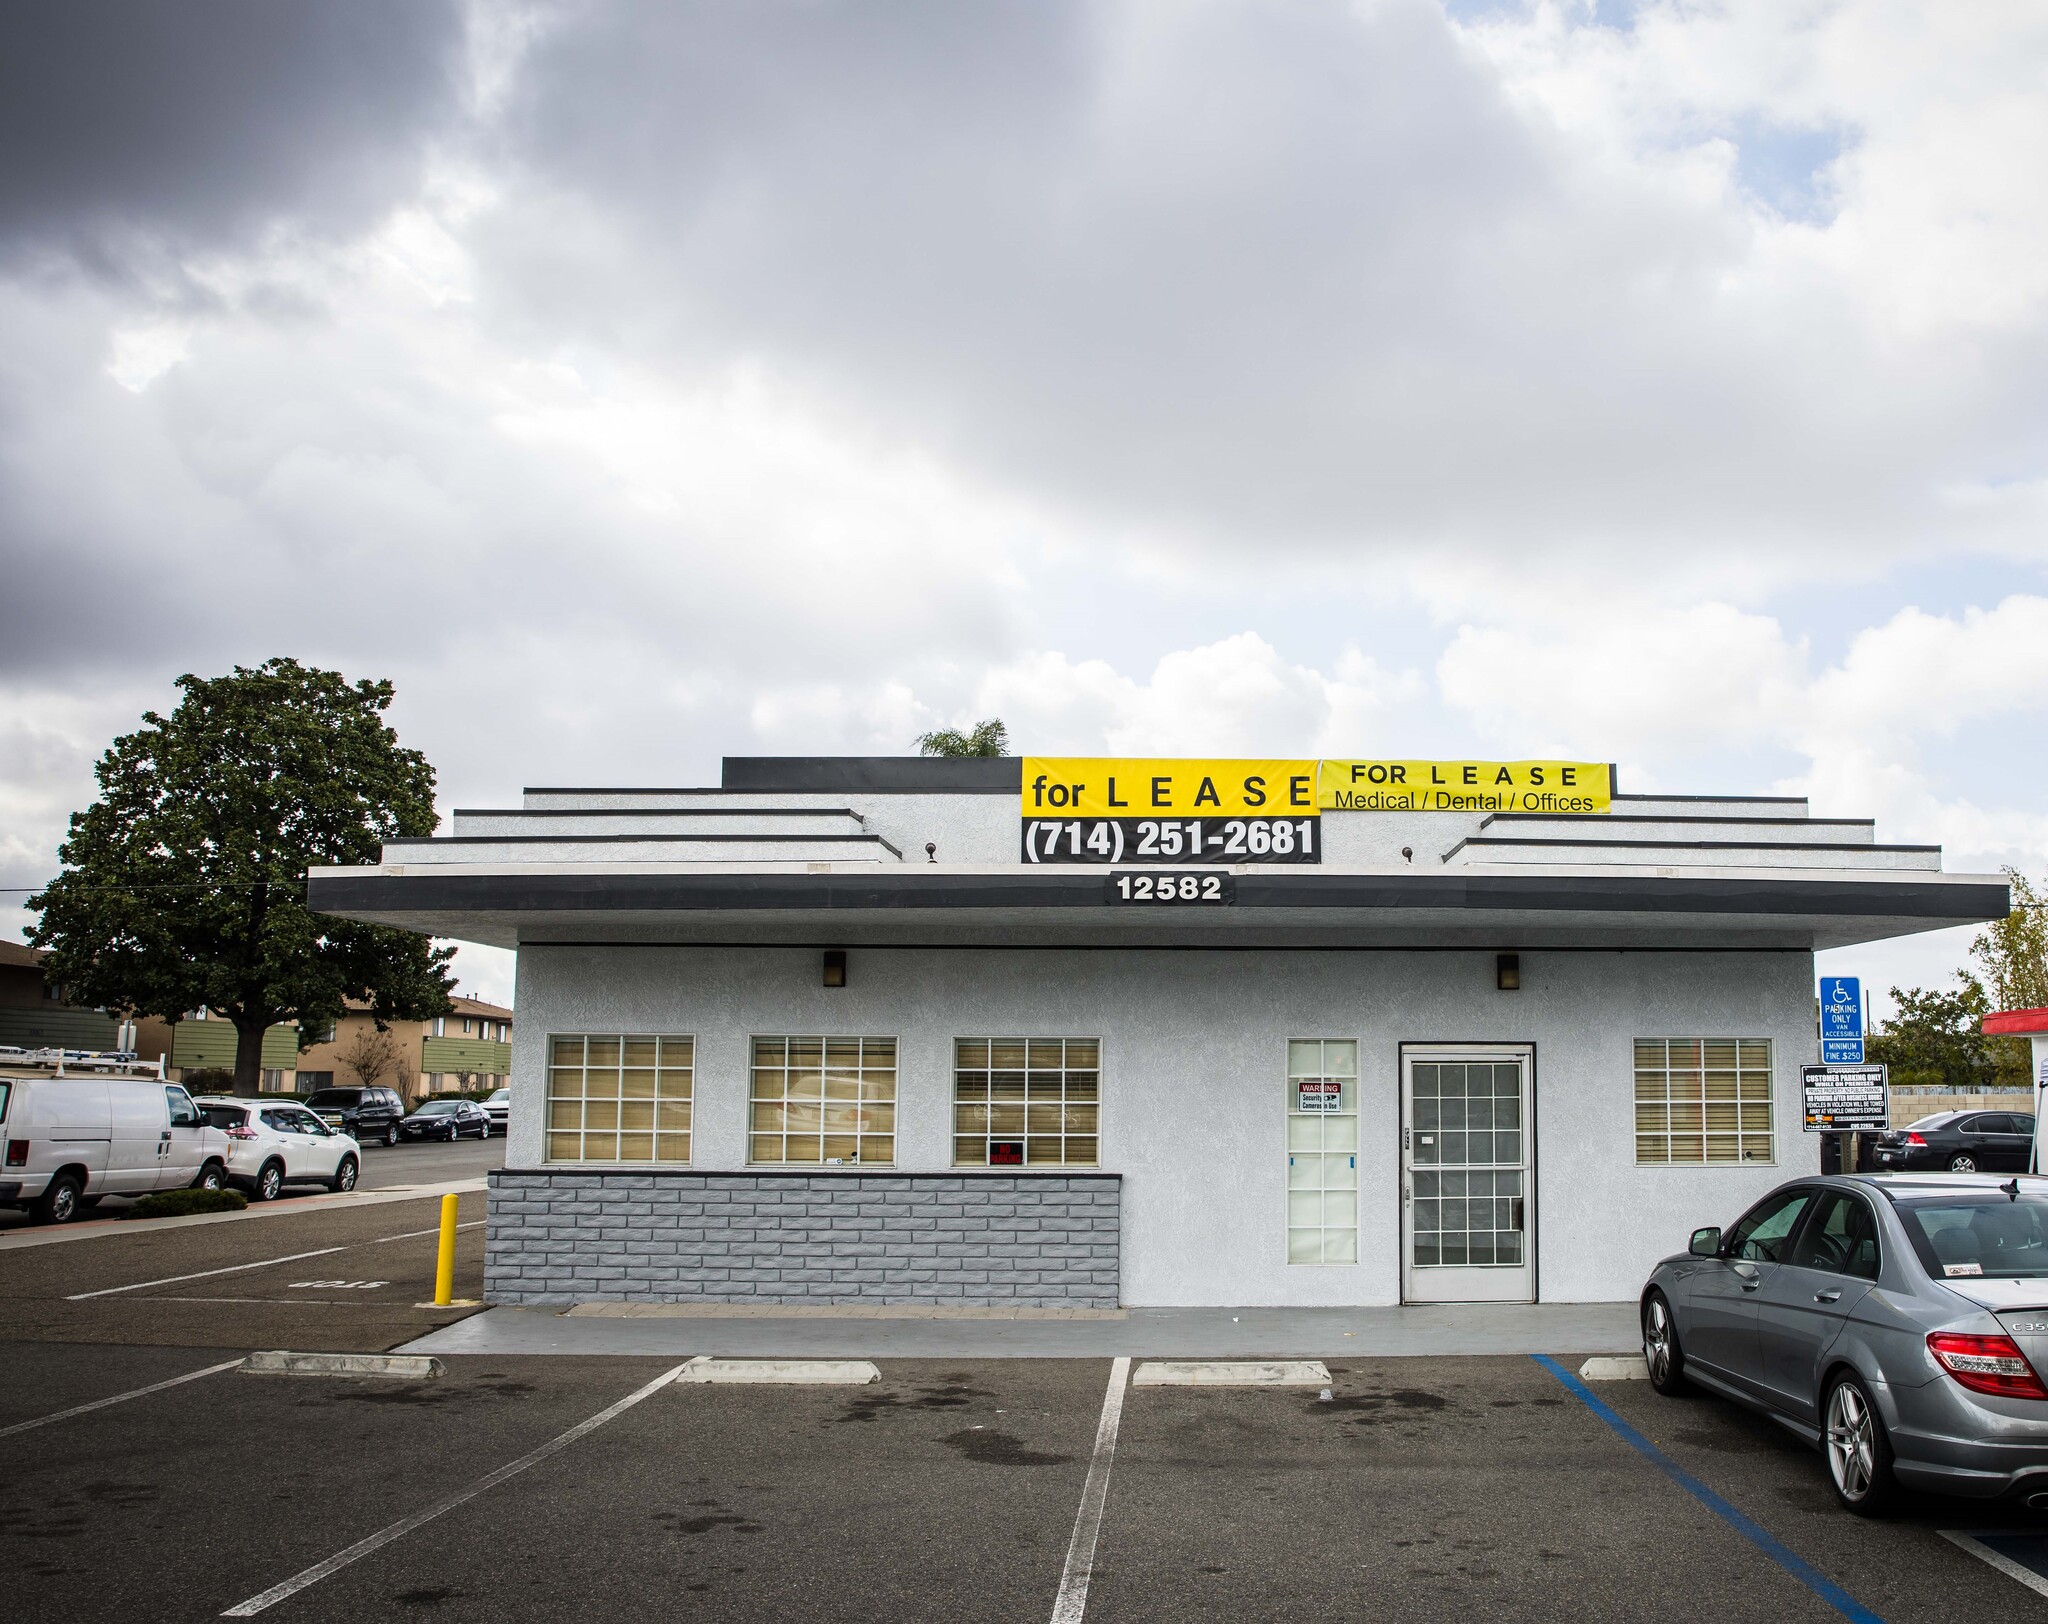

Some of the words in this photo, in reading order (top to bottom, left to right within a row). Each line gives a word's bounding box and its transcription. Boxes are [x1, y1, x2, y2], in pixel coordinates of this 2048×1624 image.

[1351, 765, 1406, 784] FOR
[1432, 766, 1576, 786] LEASE
[1032, 775, 1085, 807] for
[1108, 776, 1310, 807] LEASE
[1335, 790, 1414, 809] Medical
[1436, 791, 1501, 810] Dental
[1523, 792, 1593, 811] Offices
[1026, 820, 1125, 863] (714)
[1137, 820, 1312, 855] 251-2681
[1117, 876, 1221, 900] 12582
[1824, 1004, 1857, 1013] PAKING
[1832, 1014, 1850, 1023] ONLY
[1828, 1042, 1857, 1050] MINIMUM
[1826, 1052, 1840, 1060] FINE
[1842, 1051, 1860, 1060] $250
[1806, 1074, 1839, 1082] CUSTOMER
[1840, 1074, 1866, 1082] PARKING
[1867, 1073, 1881, 1081] ONLY
[1000, 1144, 1011, 1153] NO
[990, 1154, 1021, 1164] PARKING
[2012, 1323, 2022, 1331] C
